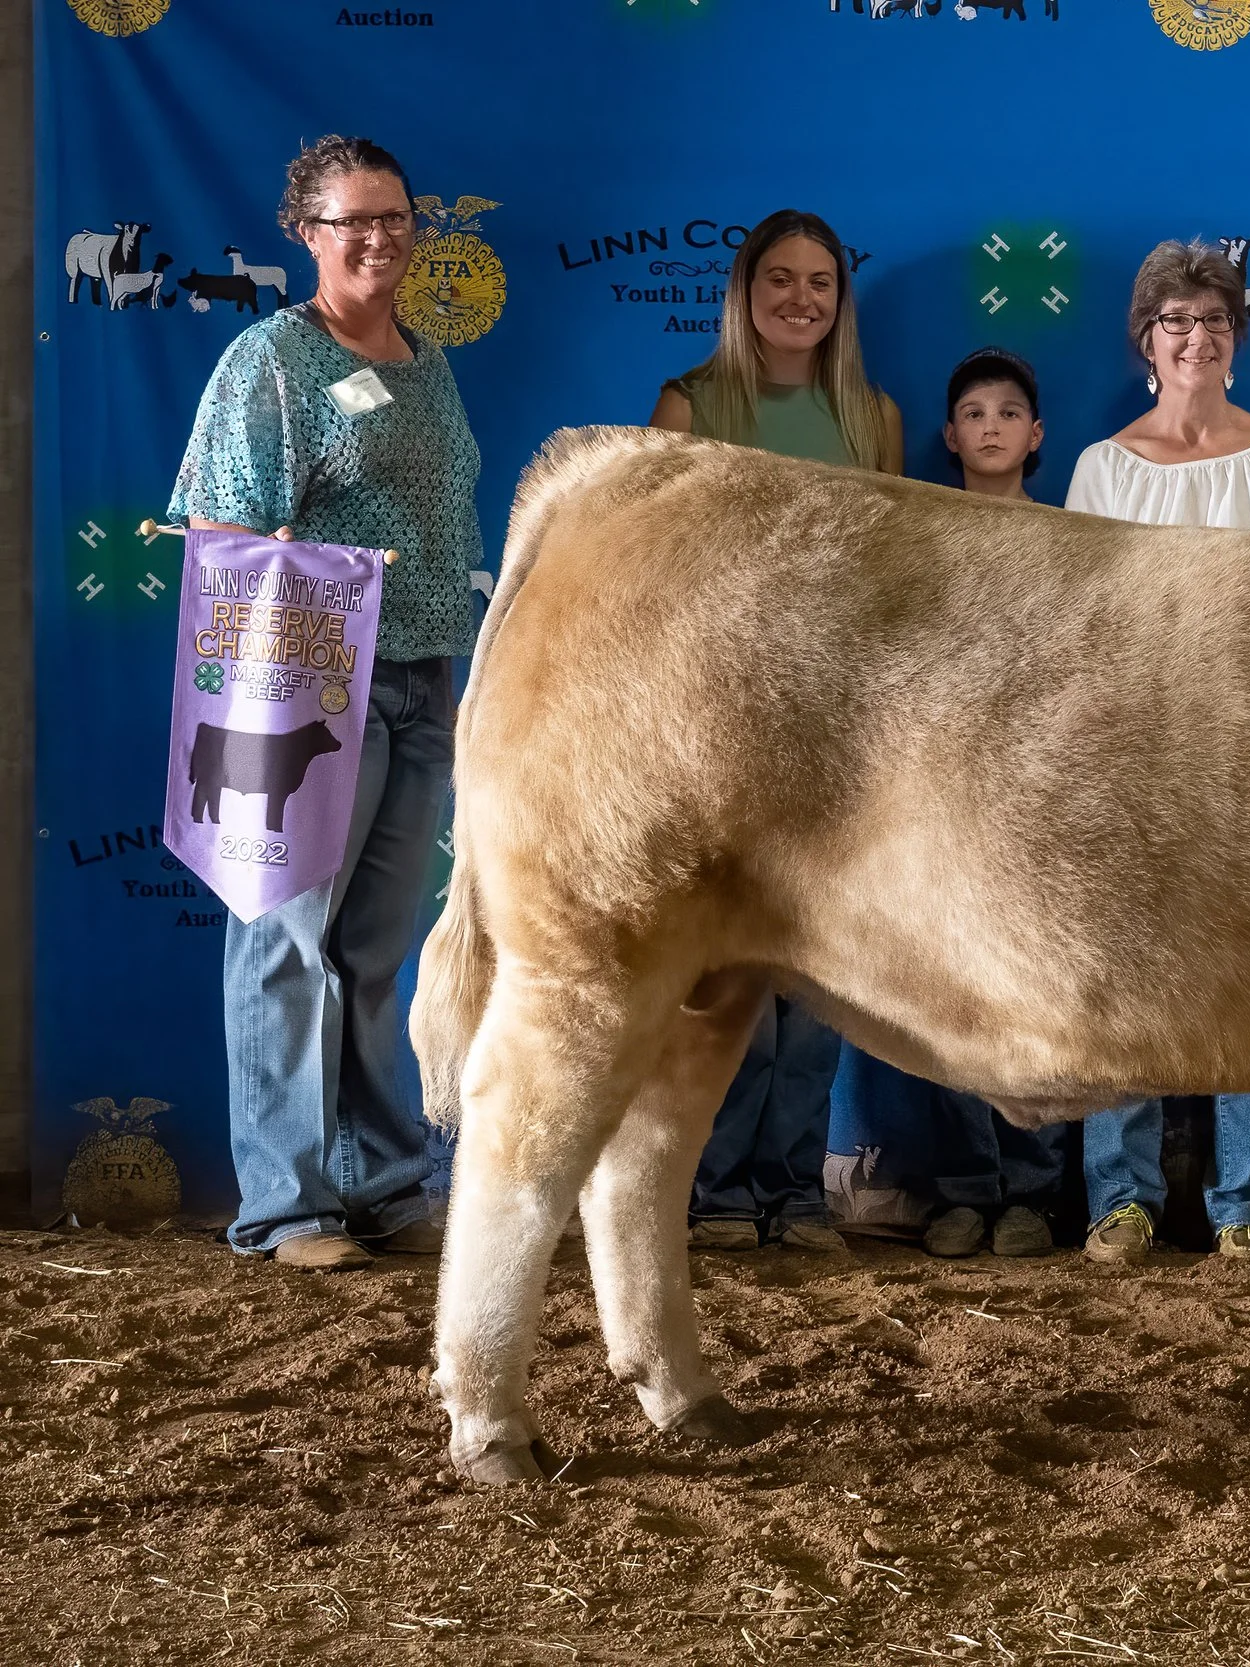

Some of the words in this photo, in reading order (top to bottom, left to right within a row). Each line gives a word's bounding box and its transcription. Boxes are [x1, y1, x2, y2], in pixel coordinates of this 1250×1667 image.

[336, 8, 434, 26] Auction
[1172, 12, 1241, 35] EDUCATION
[558, 226, 669, 271] LINN
[409, 245, 490, 281] AGRICULTURAL
[428, 260, 474, 278] FFA
[610, 284, 687, 304] Youth
[415, 306, 485, 331] EDUCATION
[663, 315, 724, 334] Auct
[200, 566, 240, 598] LINN
[245, 570, 319, 606] COUNTY
[321, 580, 364, 613] FAIR
[211, 601, 346, 642] RESERVE
[194, 629, 357, 674] CHAMPION
[230, 664, 316, 689] MARKET
[245, 683, 295, 702] BEEF
[220, 835, 289, 867] 2022
[121, 879, 198, 898] Youth
[101, 1162, 145, 1181] FFA
